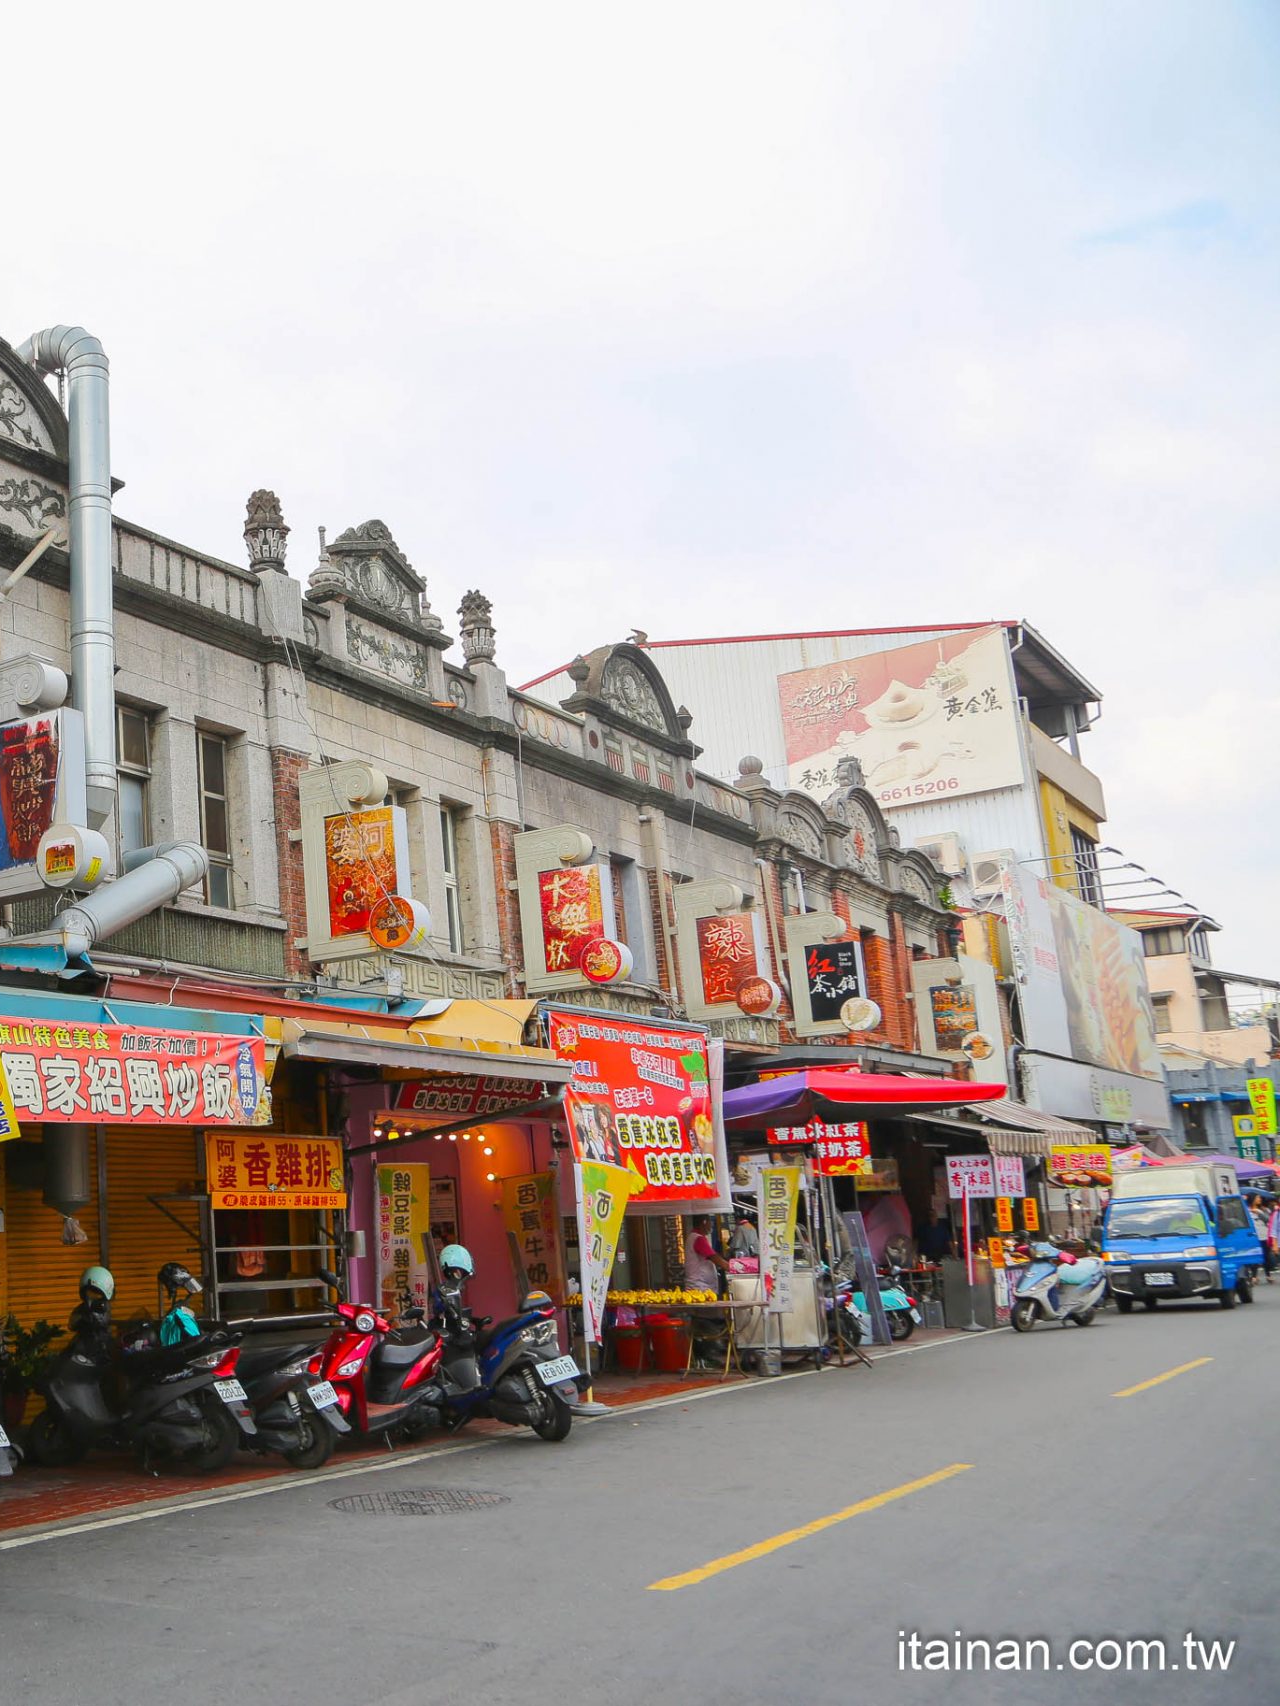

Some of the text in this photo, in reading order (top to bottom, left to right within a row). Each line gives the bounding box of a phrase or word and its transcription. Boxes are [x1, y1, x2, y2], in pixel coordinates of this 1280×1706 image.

[1, 1051, 234, 1120] 獨家紹興炒飯
[237, 1044, 256, 1111] 冷氣開放
[216, 1139, 238, 1189] 阿婆
[243, 1142, 332, 1188] 香雞排
